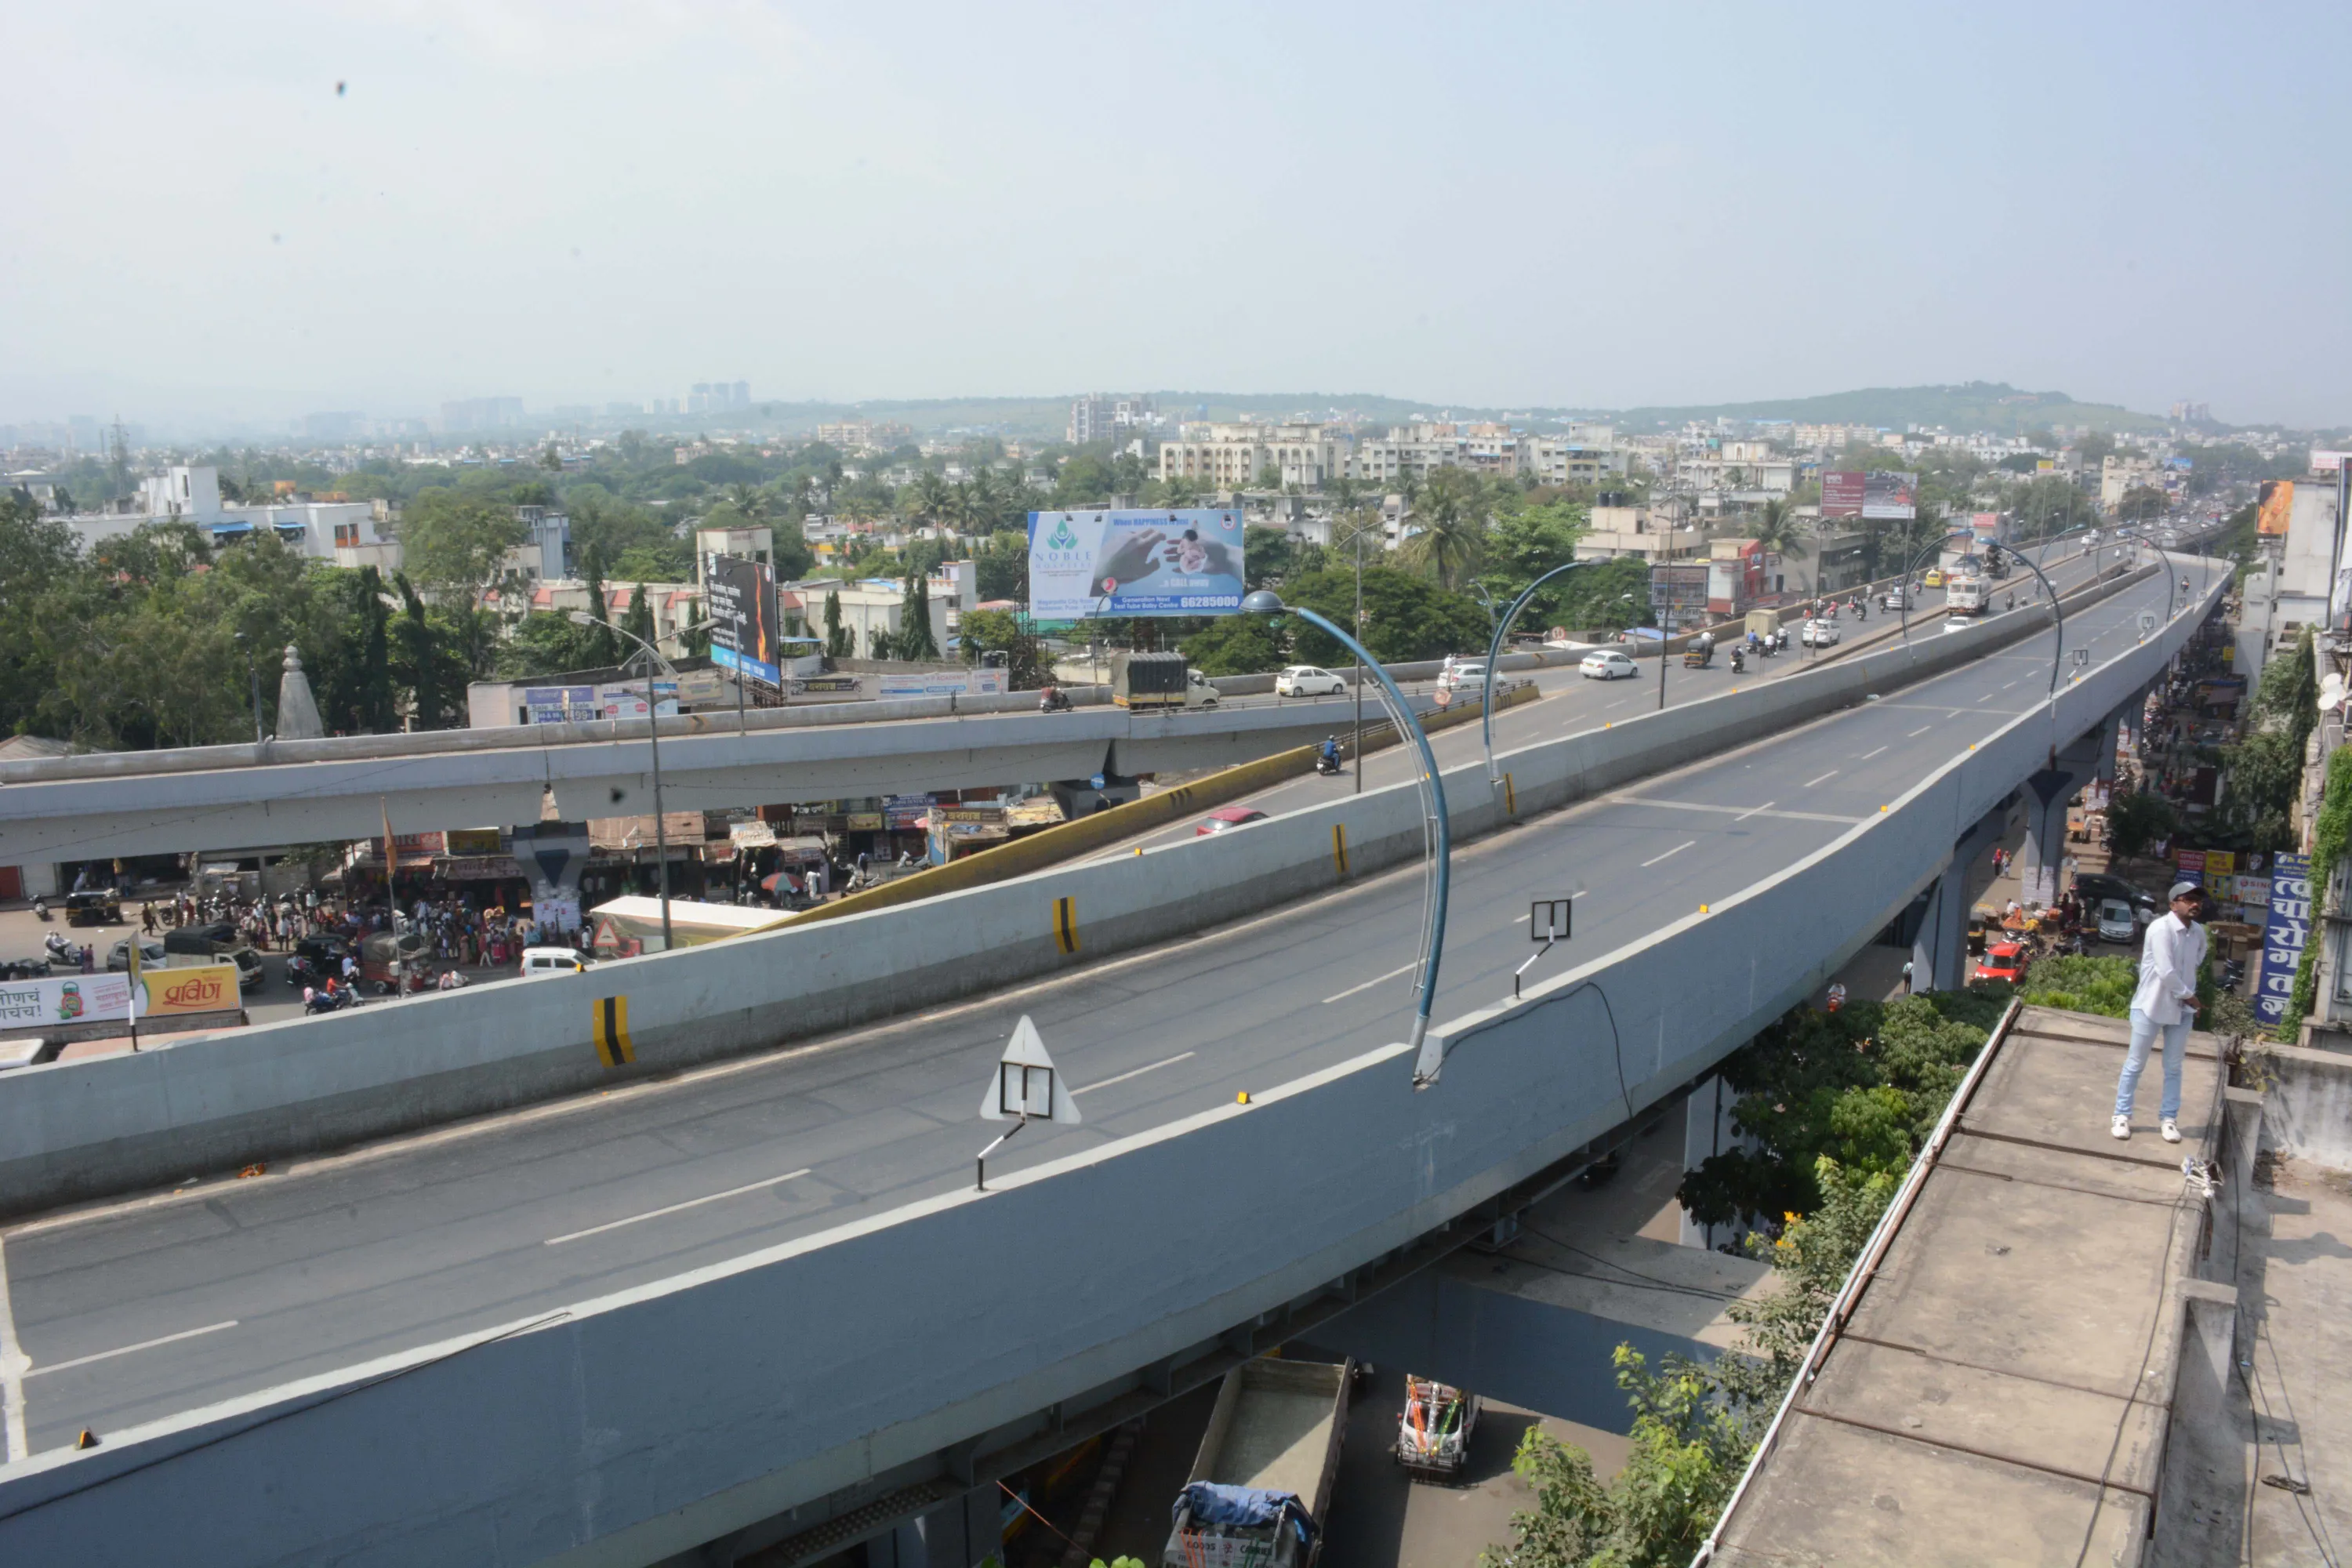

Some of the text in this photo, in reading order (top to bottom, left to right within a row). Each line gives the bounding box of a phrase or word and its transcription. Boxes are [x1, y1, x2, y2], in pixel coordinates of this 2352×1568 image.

[1133, 517, 1168, 527] HAPPINESS
[1036, 551, 1091, 561] NOBLE
[1171, 578, 1189, 587] CALL
[1181, 595, 1239, 608] 66285000
